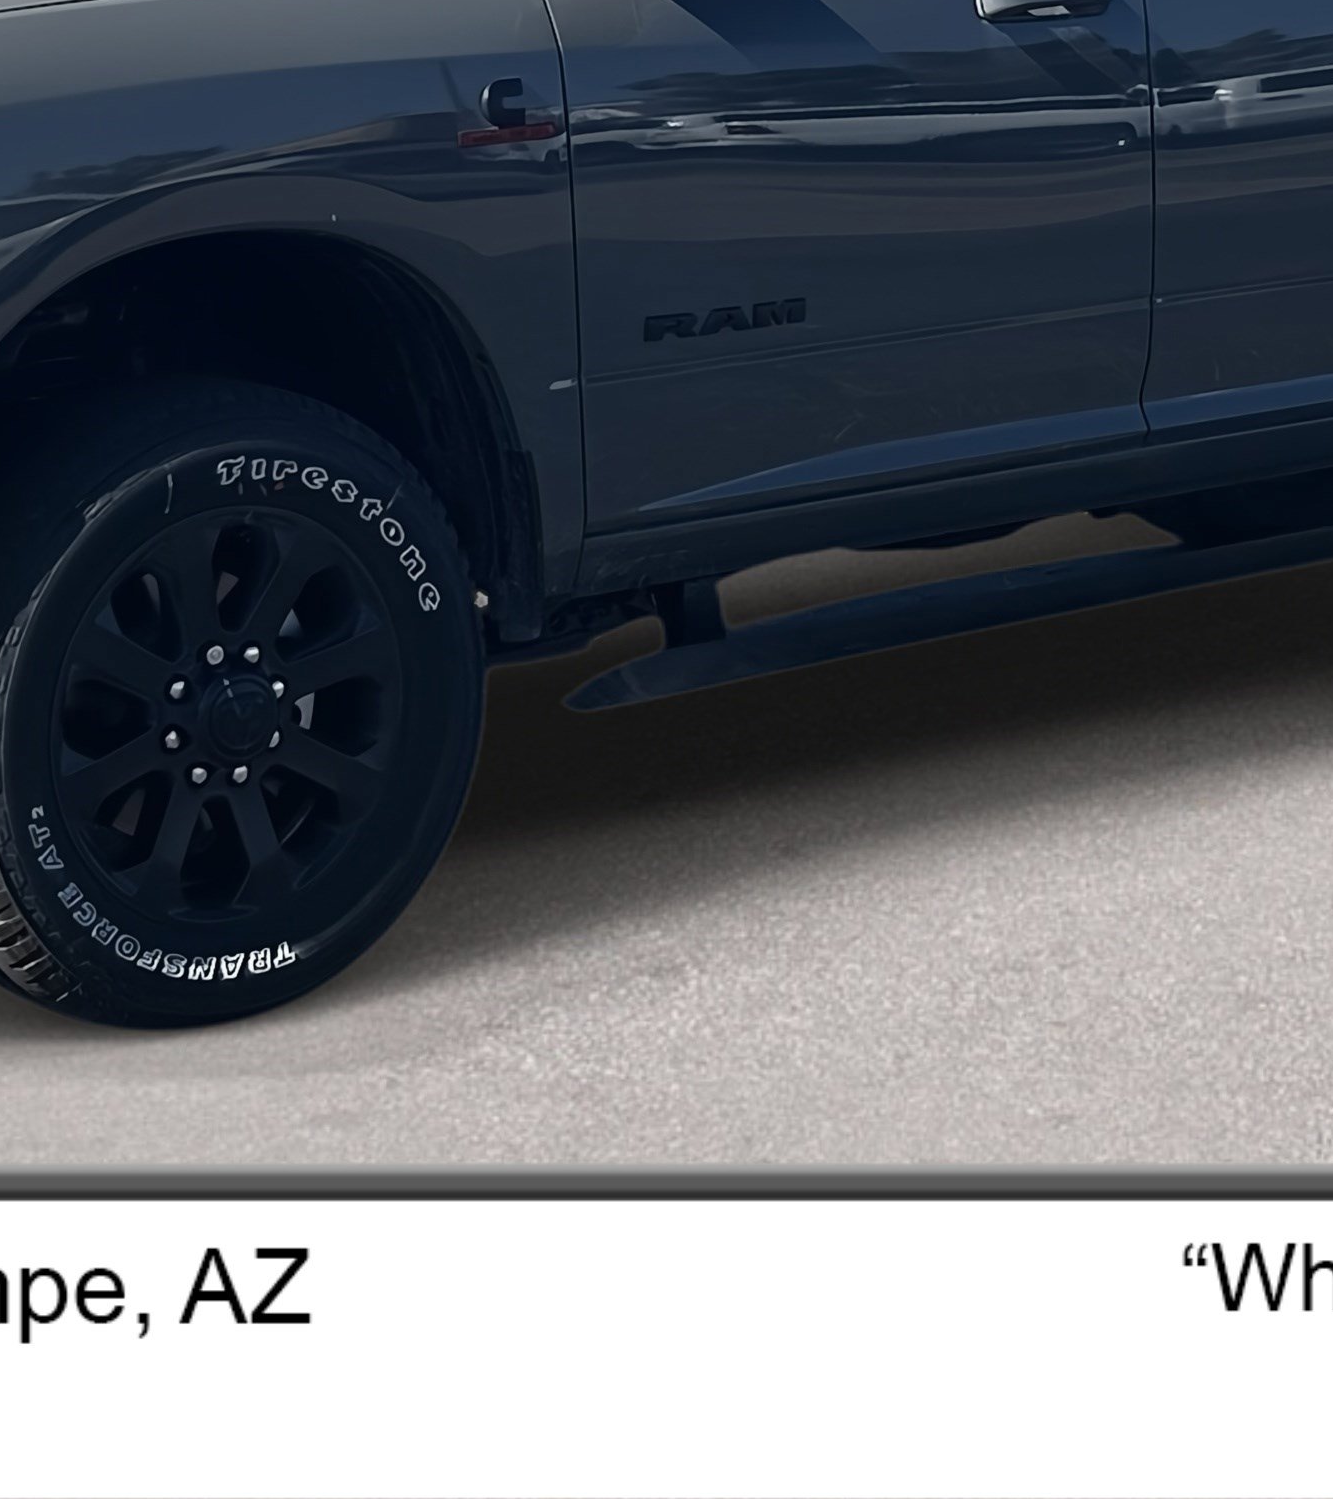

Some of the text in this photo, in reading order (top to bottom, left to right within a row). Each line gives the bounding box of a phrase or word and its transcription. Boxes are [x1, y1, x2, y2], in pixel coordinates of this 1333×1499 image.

[643, 297, 806, 342] RAM
[217, 456, 441, 613] Firestone
[57, 882, 297, 980] TRANSFORCE
